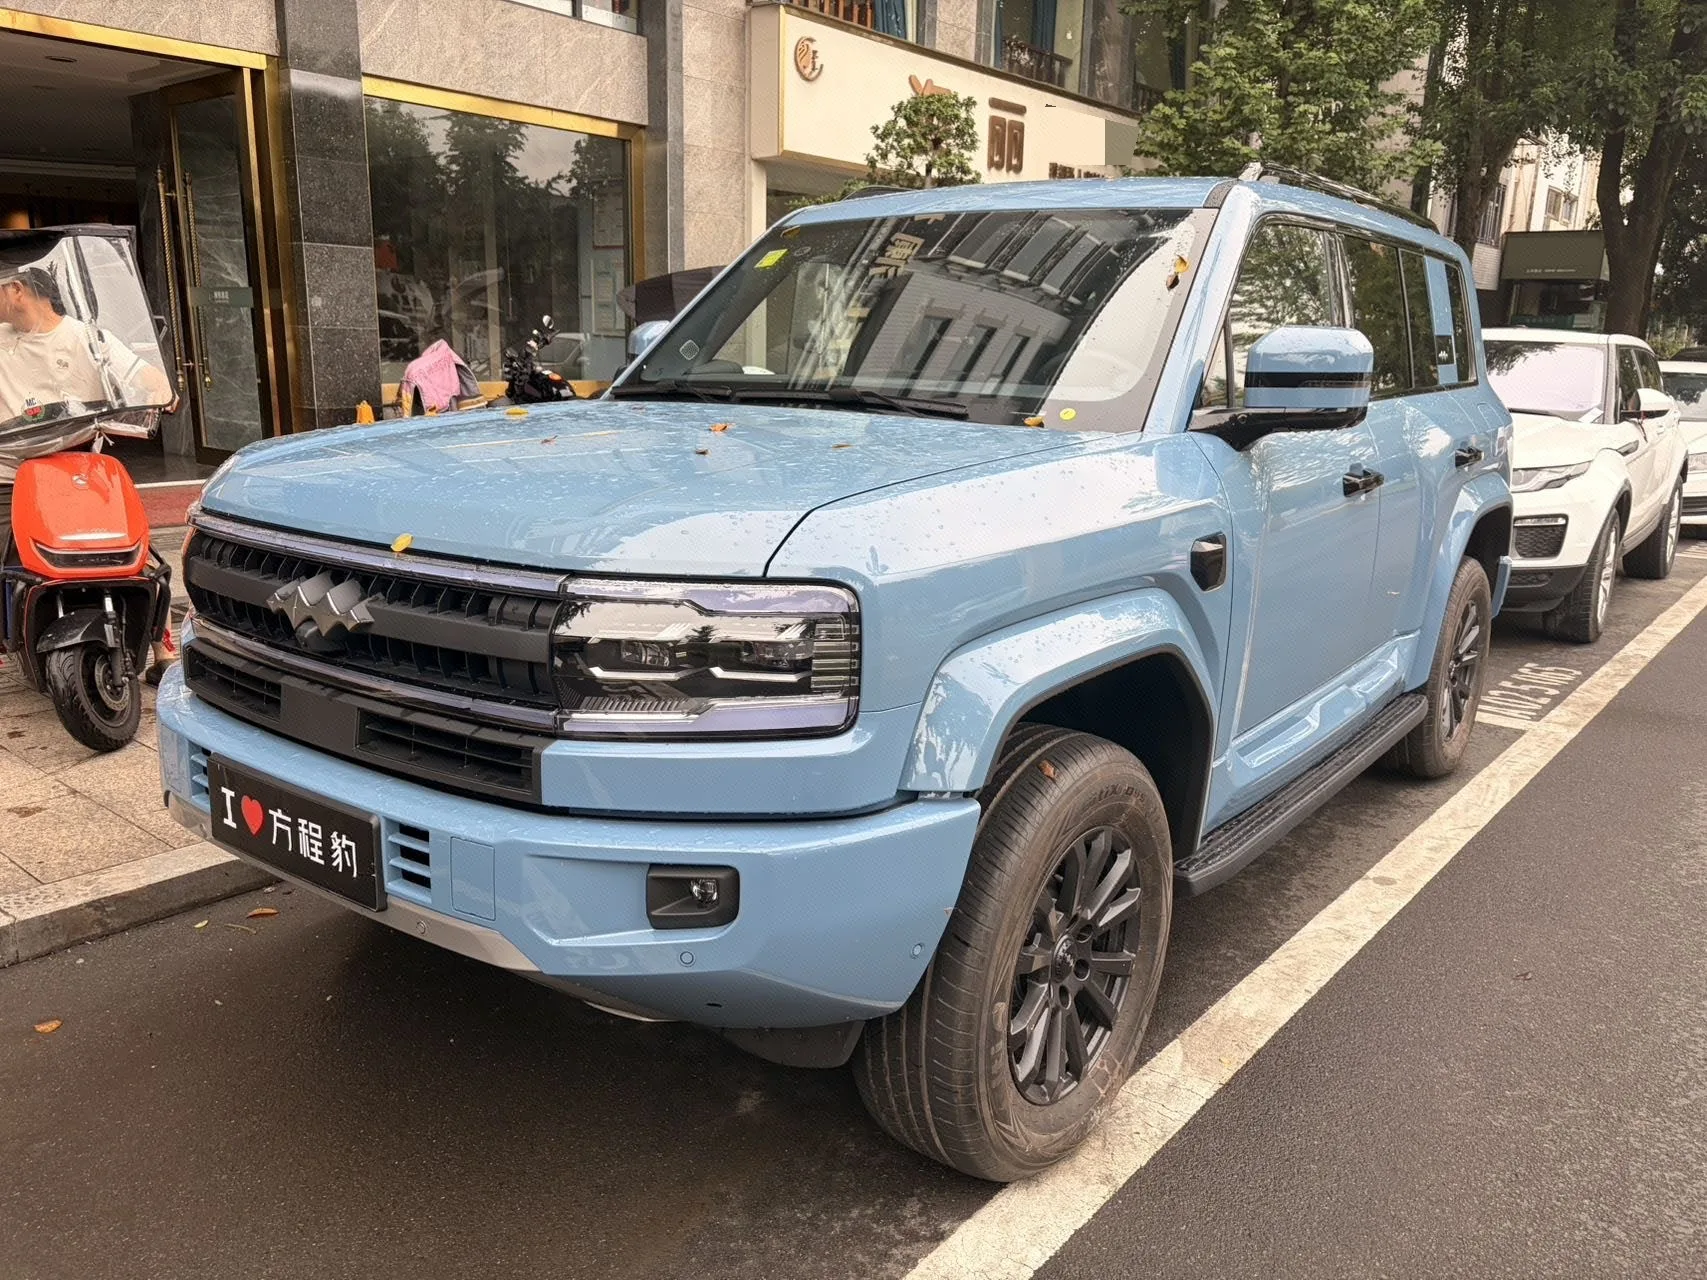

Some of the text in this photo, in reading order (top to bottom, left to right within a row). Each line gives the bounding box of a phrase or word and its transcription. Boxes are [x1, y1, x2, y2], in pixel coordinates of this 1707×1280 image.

[221, 786, 358, 878] I 方程豹
